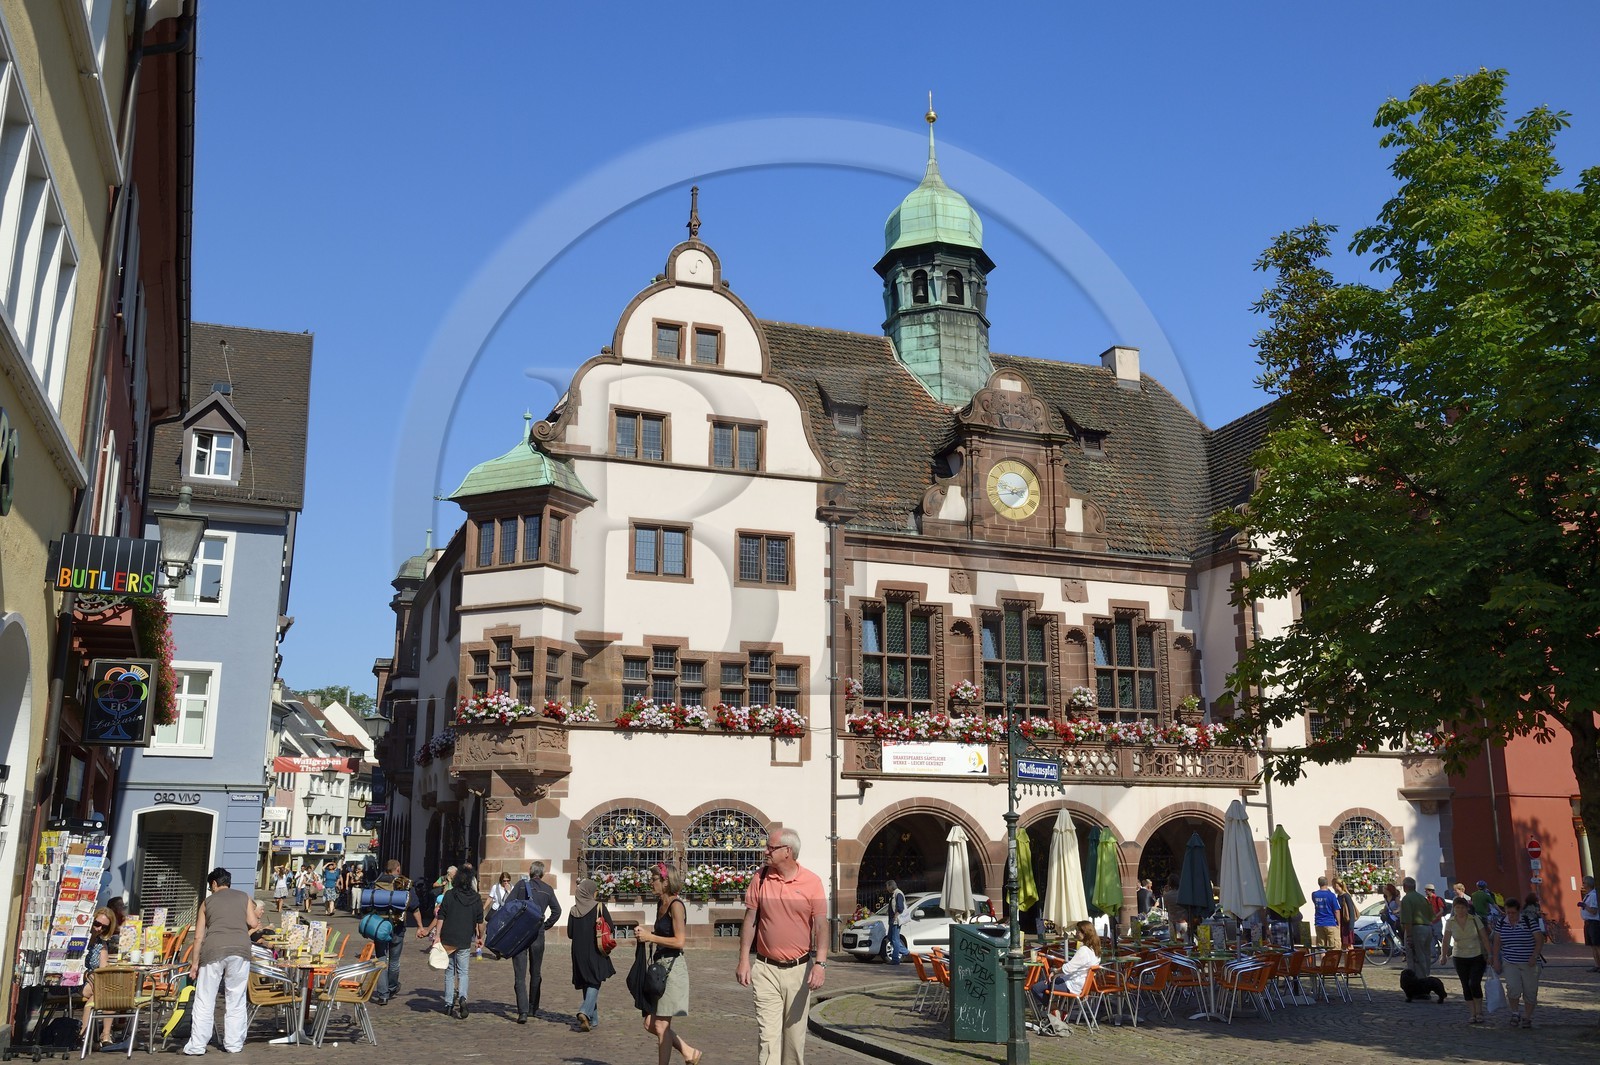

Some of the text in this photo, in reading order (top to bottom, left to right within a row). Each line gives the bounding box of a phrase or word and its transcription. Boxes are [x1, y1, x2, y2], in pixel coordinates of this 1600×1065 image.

[59, 567, 154, 594] BUTLERS
[110, 702, 127, 711] EIS
[293, 757, 342, 766] Wallgraben
[1019, 762, 1057, 778] Rathausplatz
[154, 792, 201, 802] ORO VIVO
